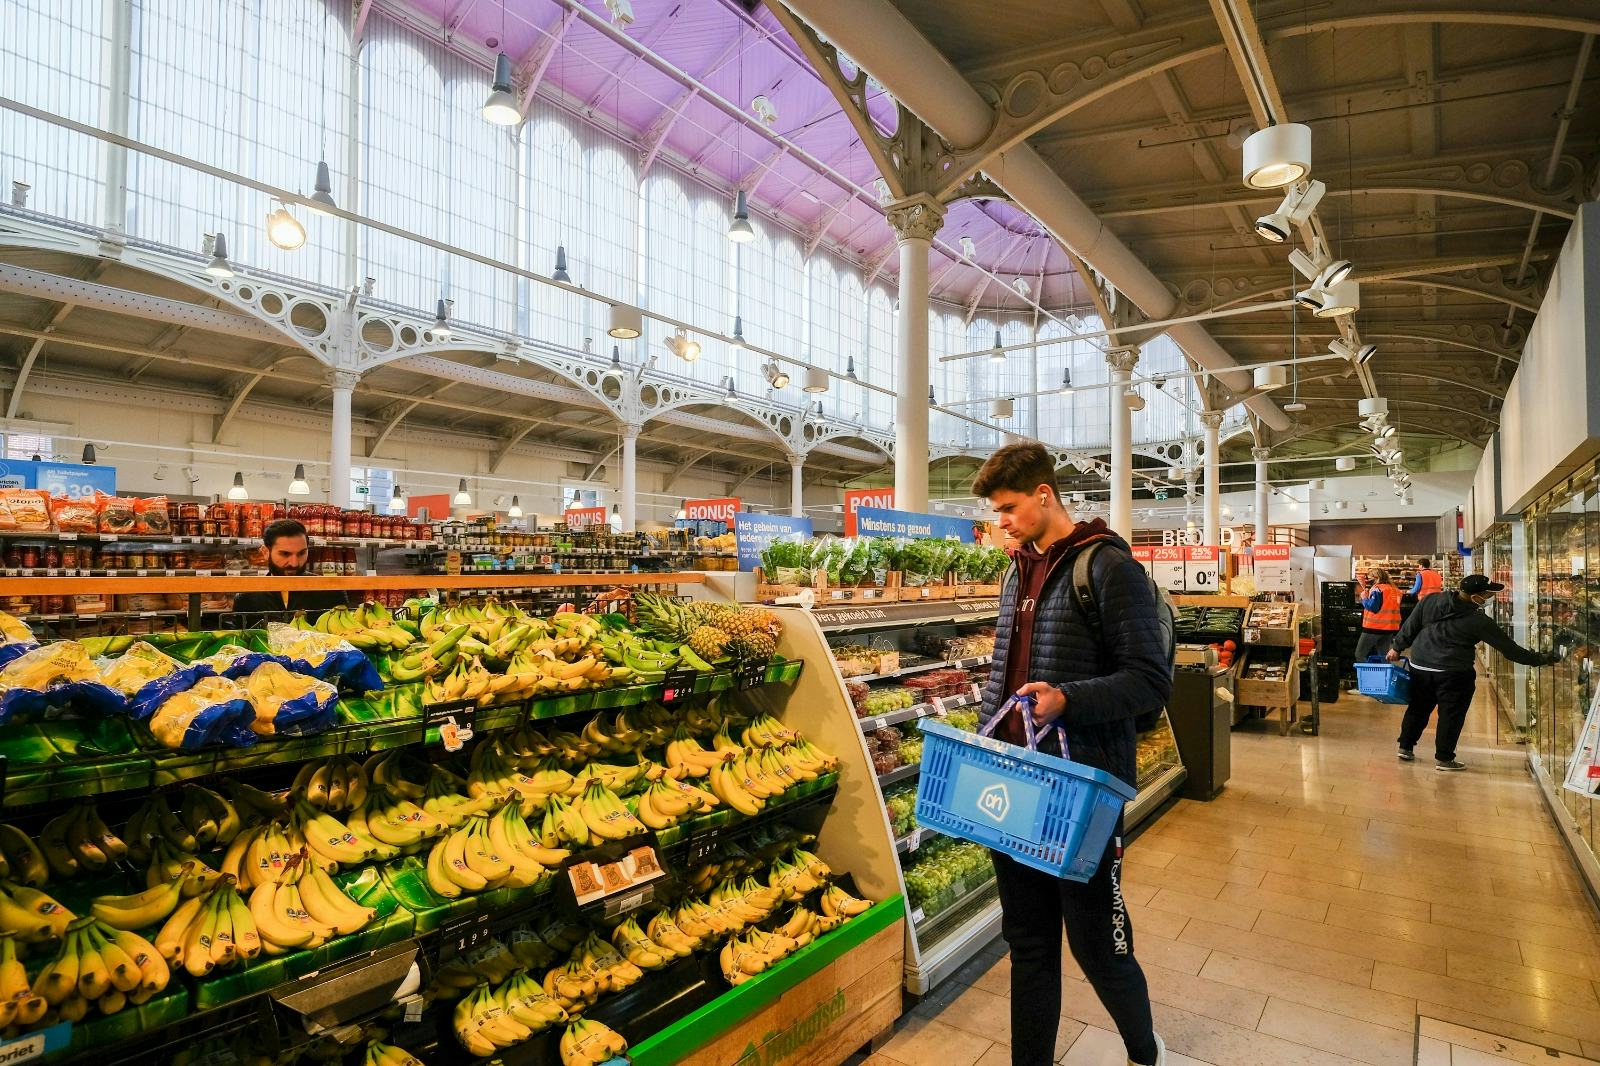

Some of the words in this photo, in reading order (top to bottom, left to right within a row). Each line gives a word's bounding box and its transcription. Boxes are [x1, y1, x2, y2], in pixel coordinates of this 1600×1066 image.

[689, 504, 736, 520] BONUS
[738, 520, 752, 531] Het
[753, 522, 778, 533] geheim
[780, 525, 792, 533] van
[861, 517, 895, 532] Minstens
[897, 525, 905, 533] zo
[907, 524, 931, 536] gezond
[1162, 527, 1234, 547] BROD
[1154, 548, 1178, 559] 25%
[1191, 547, 1212, 556] 25%
[1255, 548, 1288, 556] BONUS
[1196, 571, 1216, 585] 0.97
[971, 601, 992, 612] gekoeld
[814, 612, 836, 623] Vers
[836, 609, 869, 624] gekoeld
[866, 608, 887, 619] fruit
[1110, 857, 1125, 913] TOMMY
[458, 928, 489, 950] 1.99
[1111, 913, 1128, 955] SPORT
